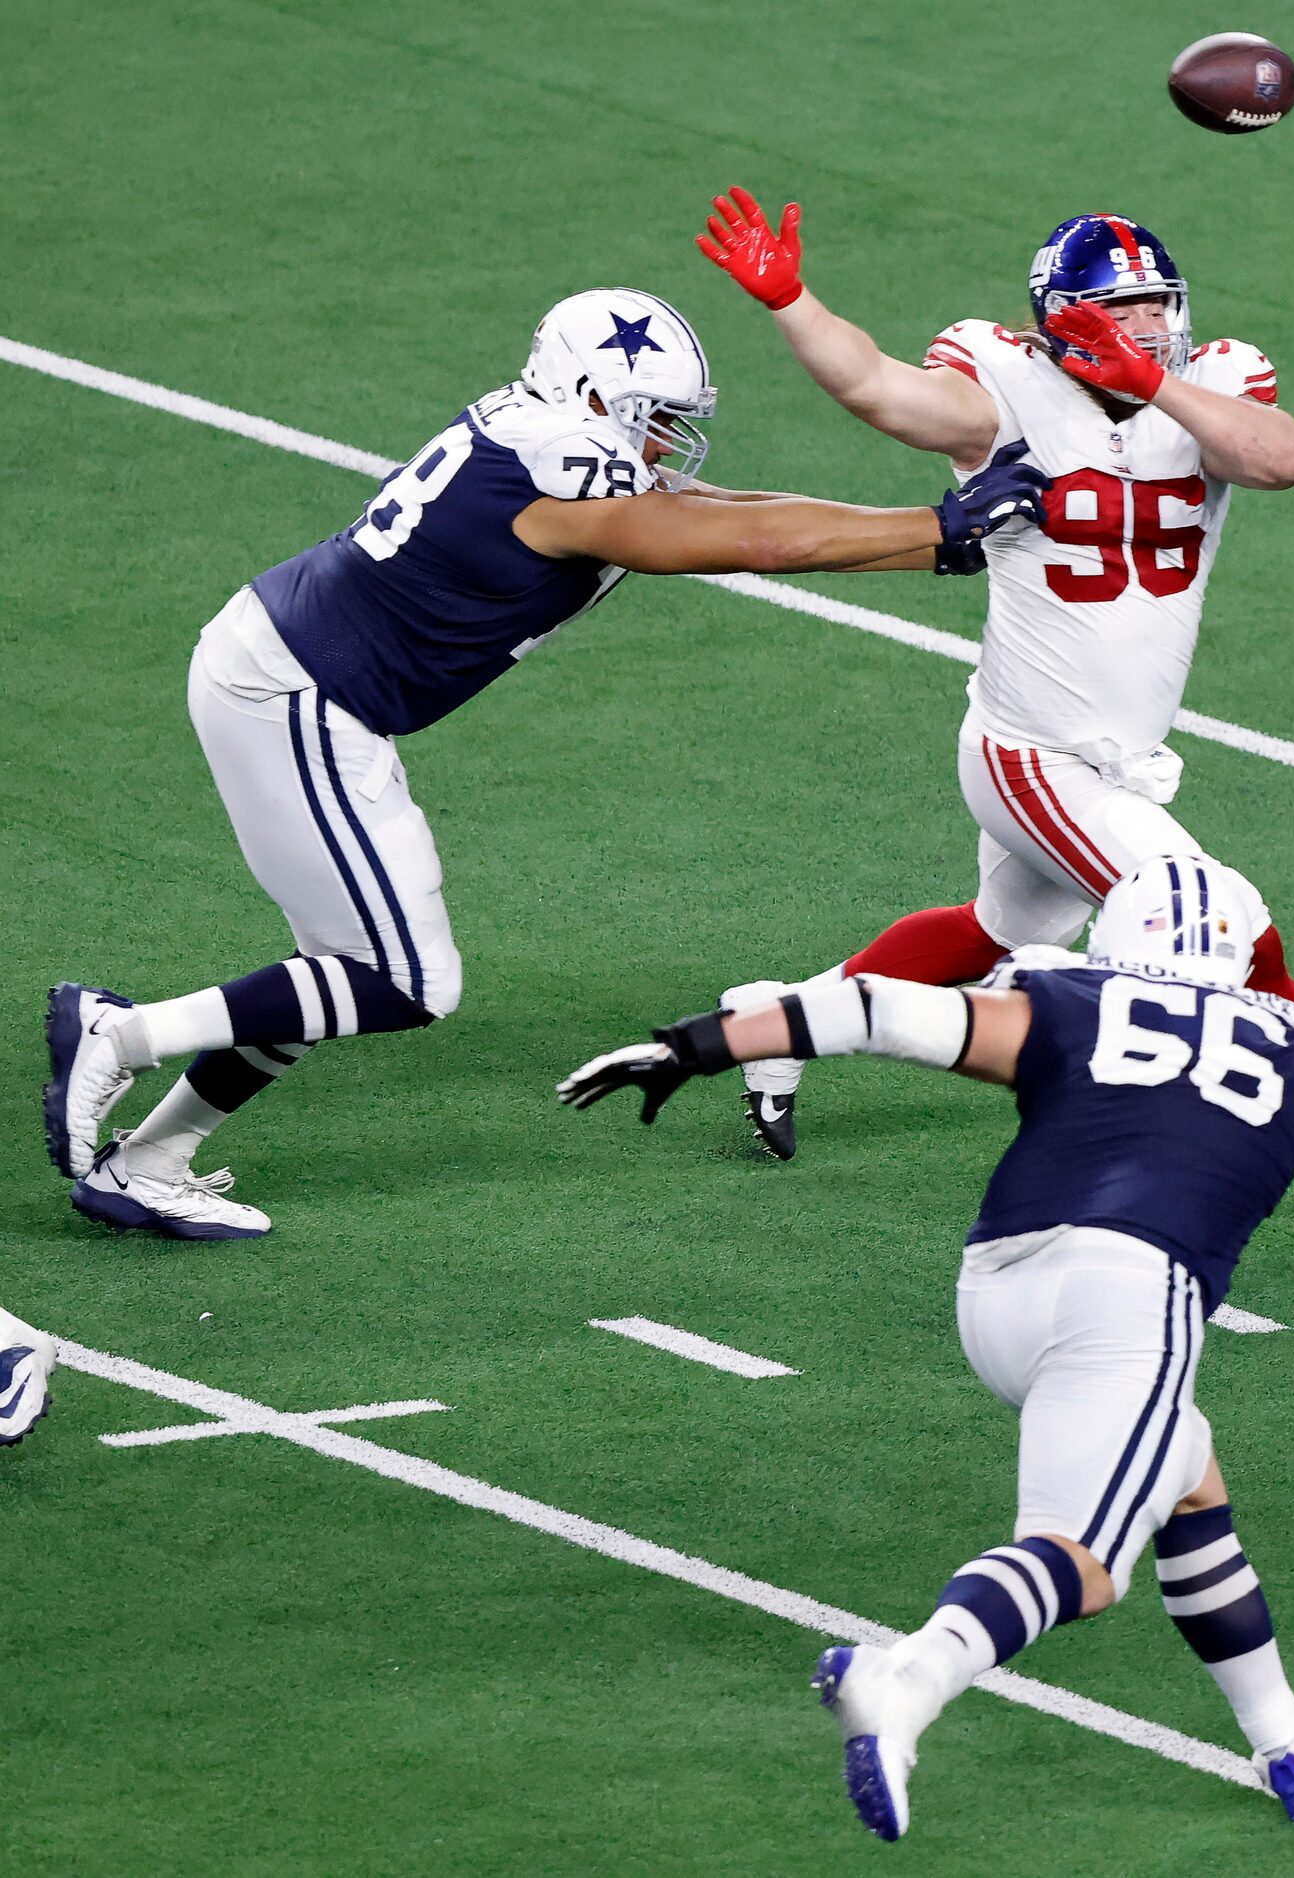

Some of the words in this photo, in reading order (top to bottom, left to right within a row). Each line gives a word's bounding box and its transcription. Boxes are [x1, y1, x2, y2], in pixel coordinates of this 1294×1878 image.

[1109, 246, 1157, 272] 96
[350, 422, 474, 562] 8
[562, 457, 637, 499] 78
[1038, 467, 1207, 603] 96
[1088, 973, 1288, 1127] 66
